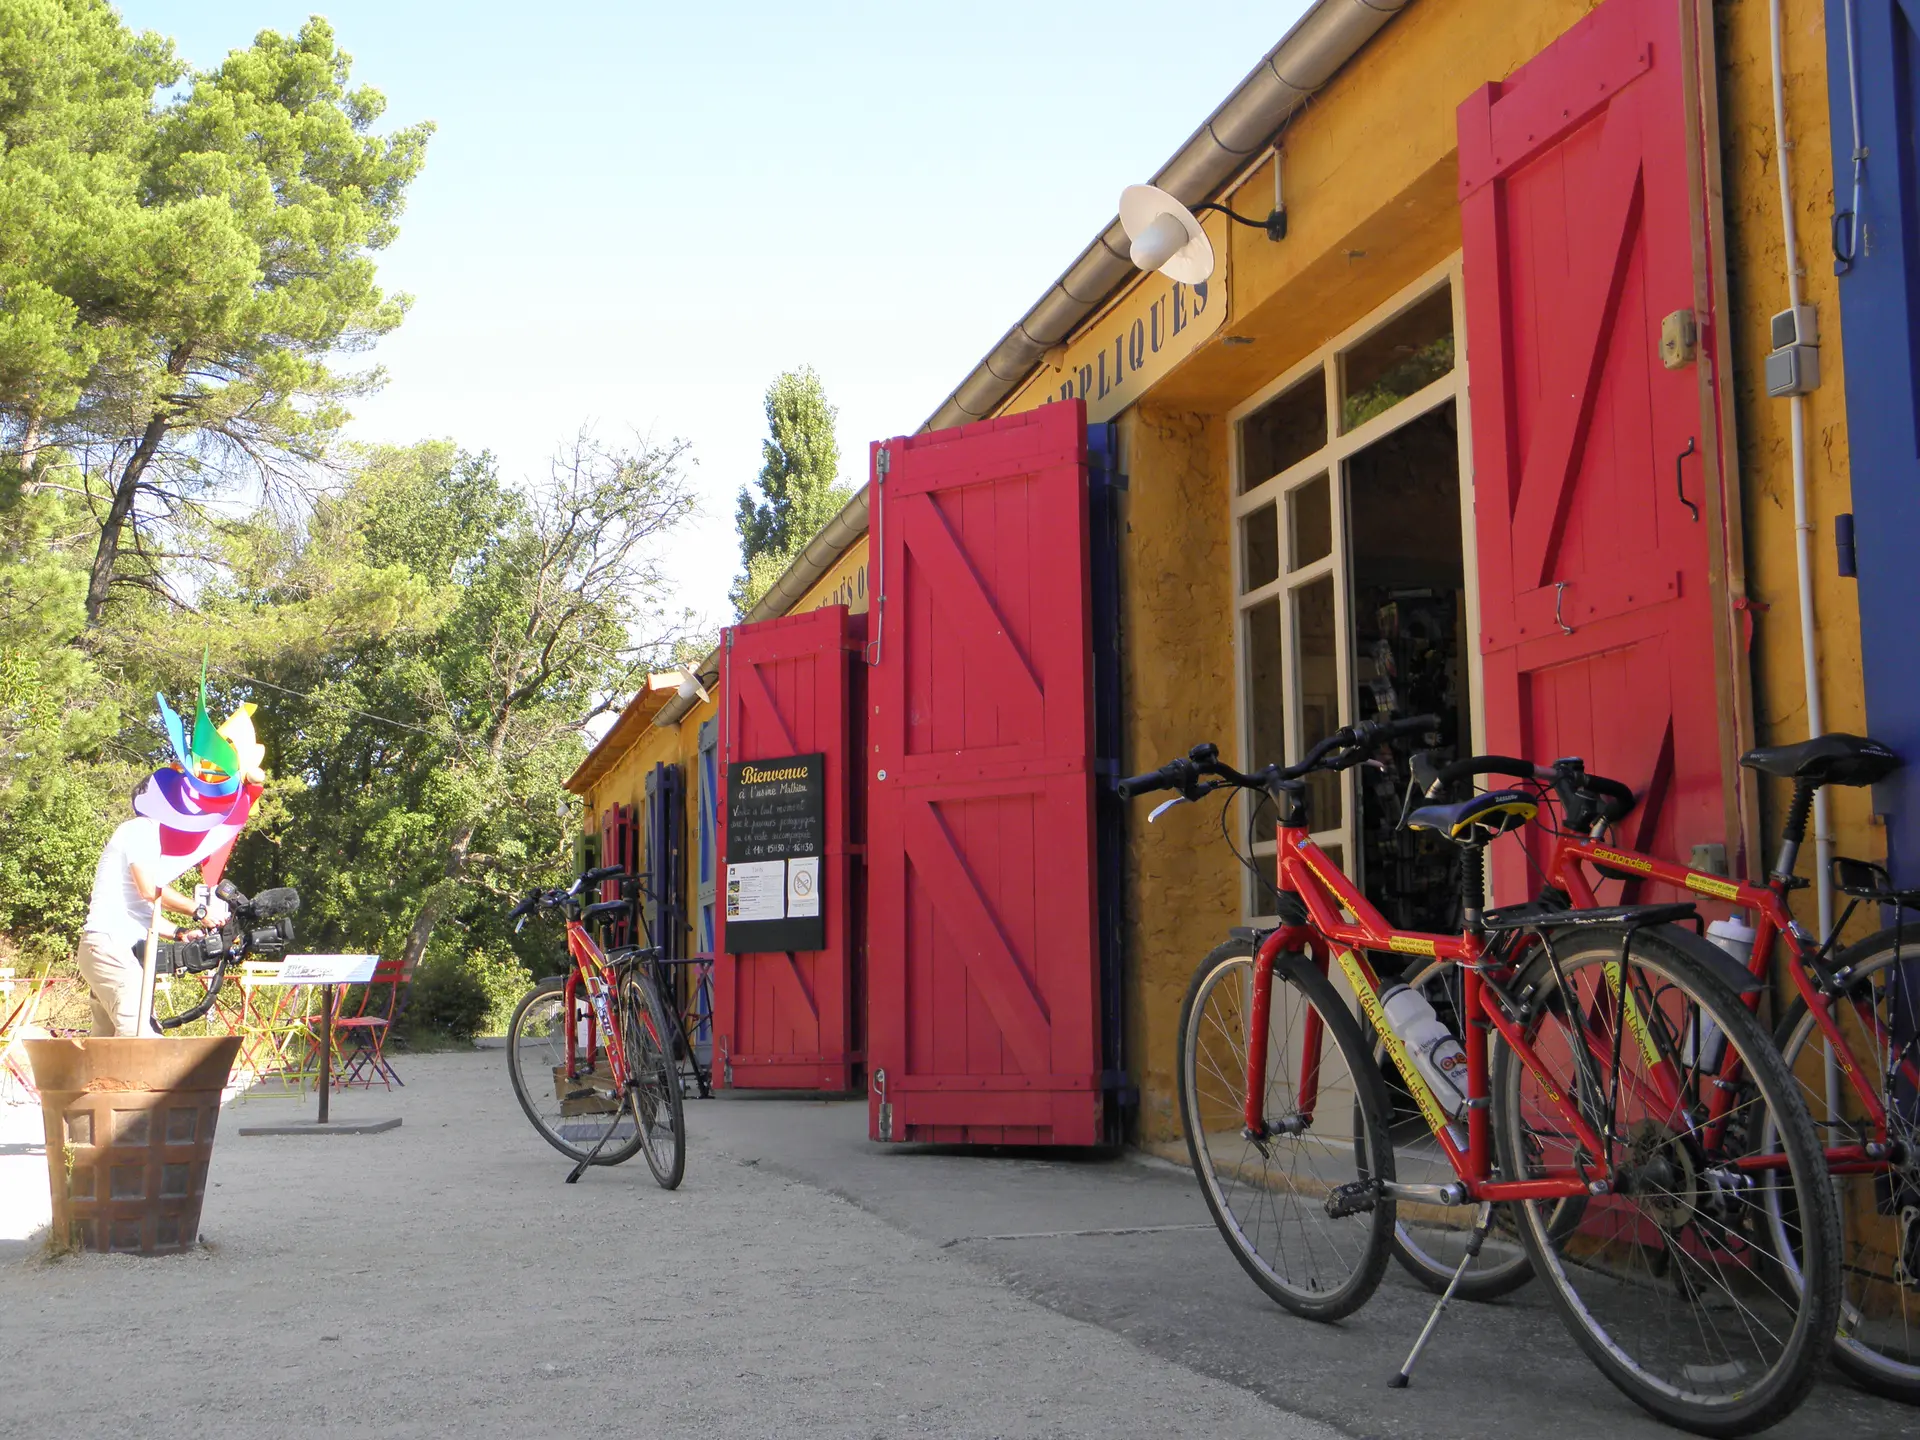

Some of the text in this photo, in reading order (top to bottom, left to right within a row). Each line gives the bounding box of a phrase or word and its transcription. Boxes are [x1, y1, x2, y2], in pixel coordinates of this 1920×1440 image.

[1047, 280, 1208, 403] PLIQUES
[740, 765, 809, 785] Bienvenue
[779, 782, 808, 795] Mathieu
[1593, 848, 1652, 872] cannondale
[1605, 965, 1622, 993] Lois
[1628, 1015, 1653, 1066] Luberon
[1359, 986, 1375, 1019] Vélo
[1372, 1015, 1397, 1054] Loisir
[1395, 1057, 1406, 1073] en
[1403, 1071, 1439, 1131] Luberon
